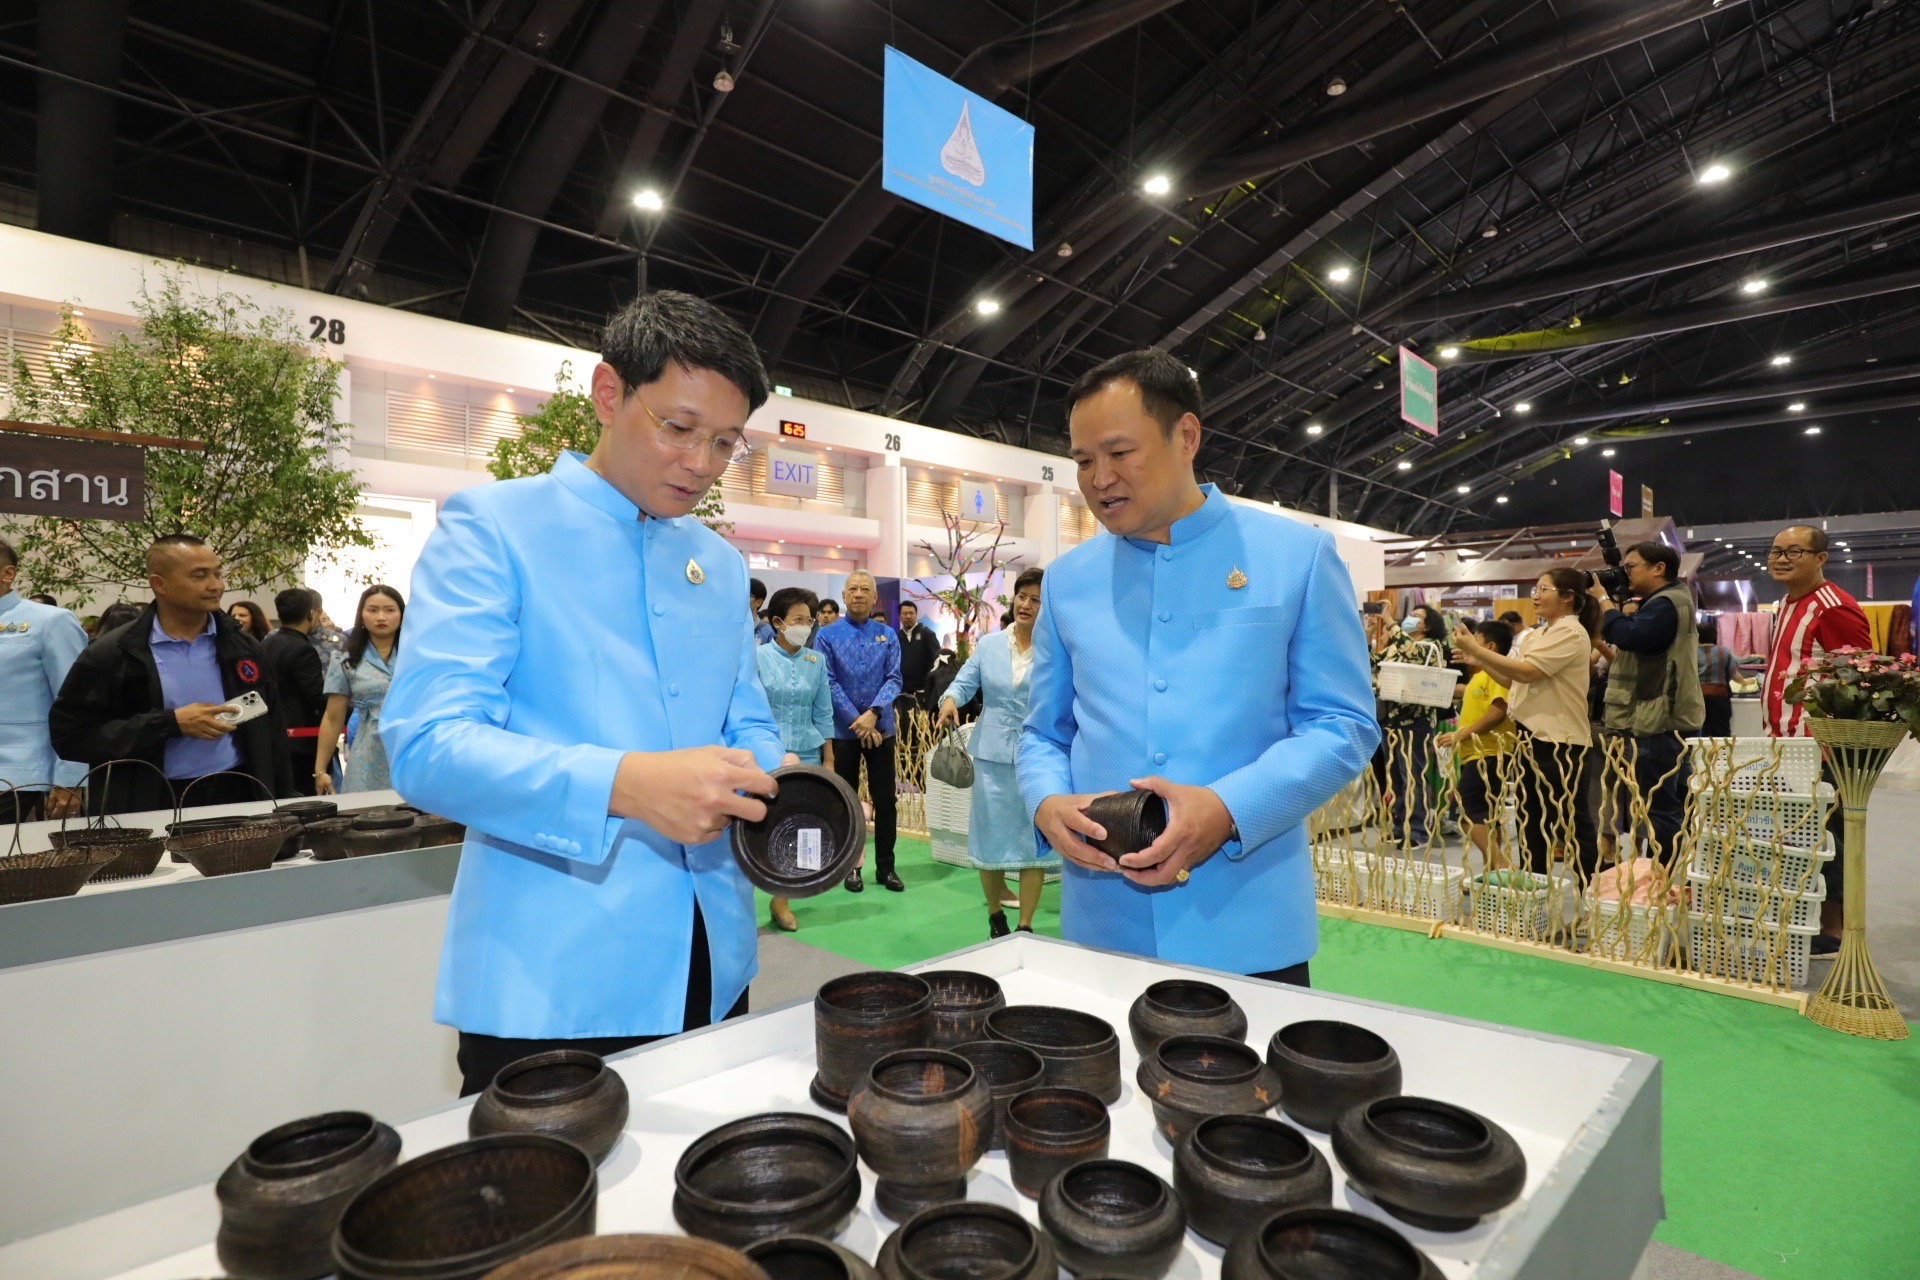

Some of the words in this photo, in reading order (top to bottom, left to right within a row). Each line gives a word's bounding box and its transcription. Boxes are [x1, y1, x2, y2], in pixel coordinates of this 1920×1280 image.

[309, 316, 345, 345] 28
[885, 433, 901, 452] 26
[774, 460, 814, 484] EXIT
[1042, 466, 1054, 482] 25
